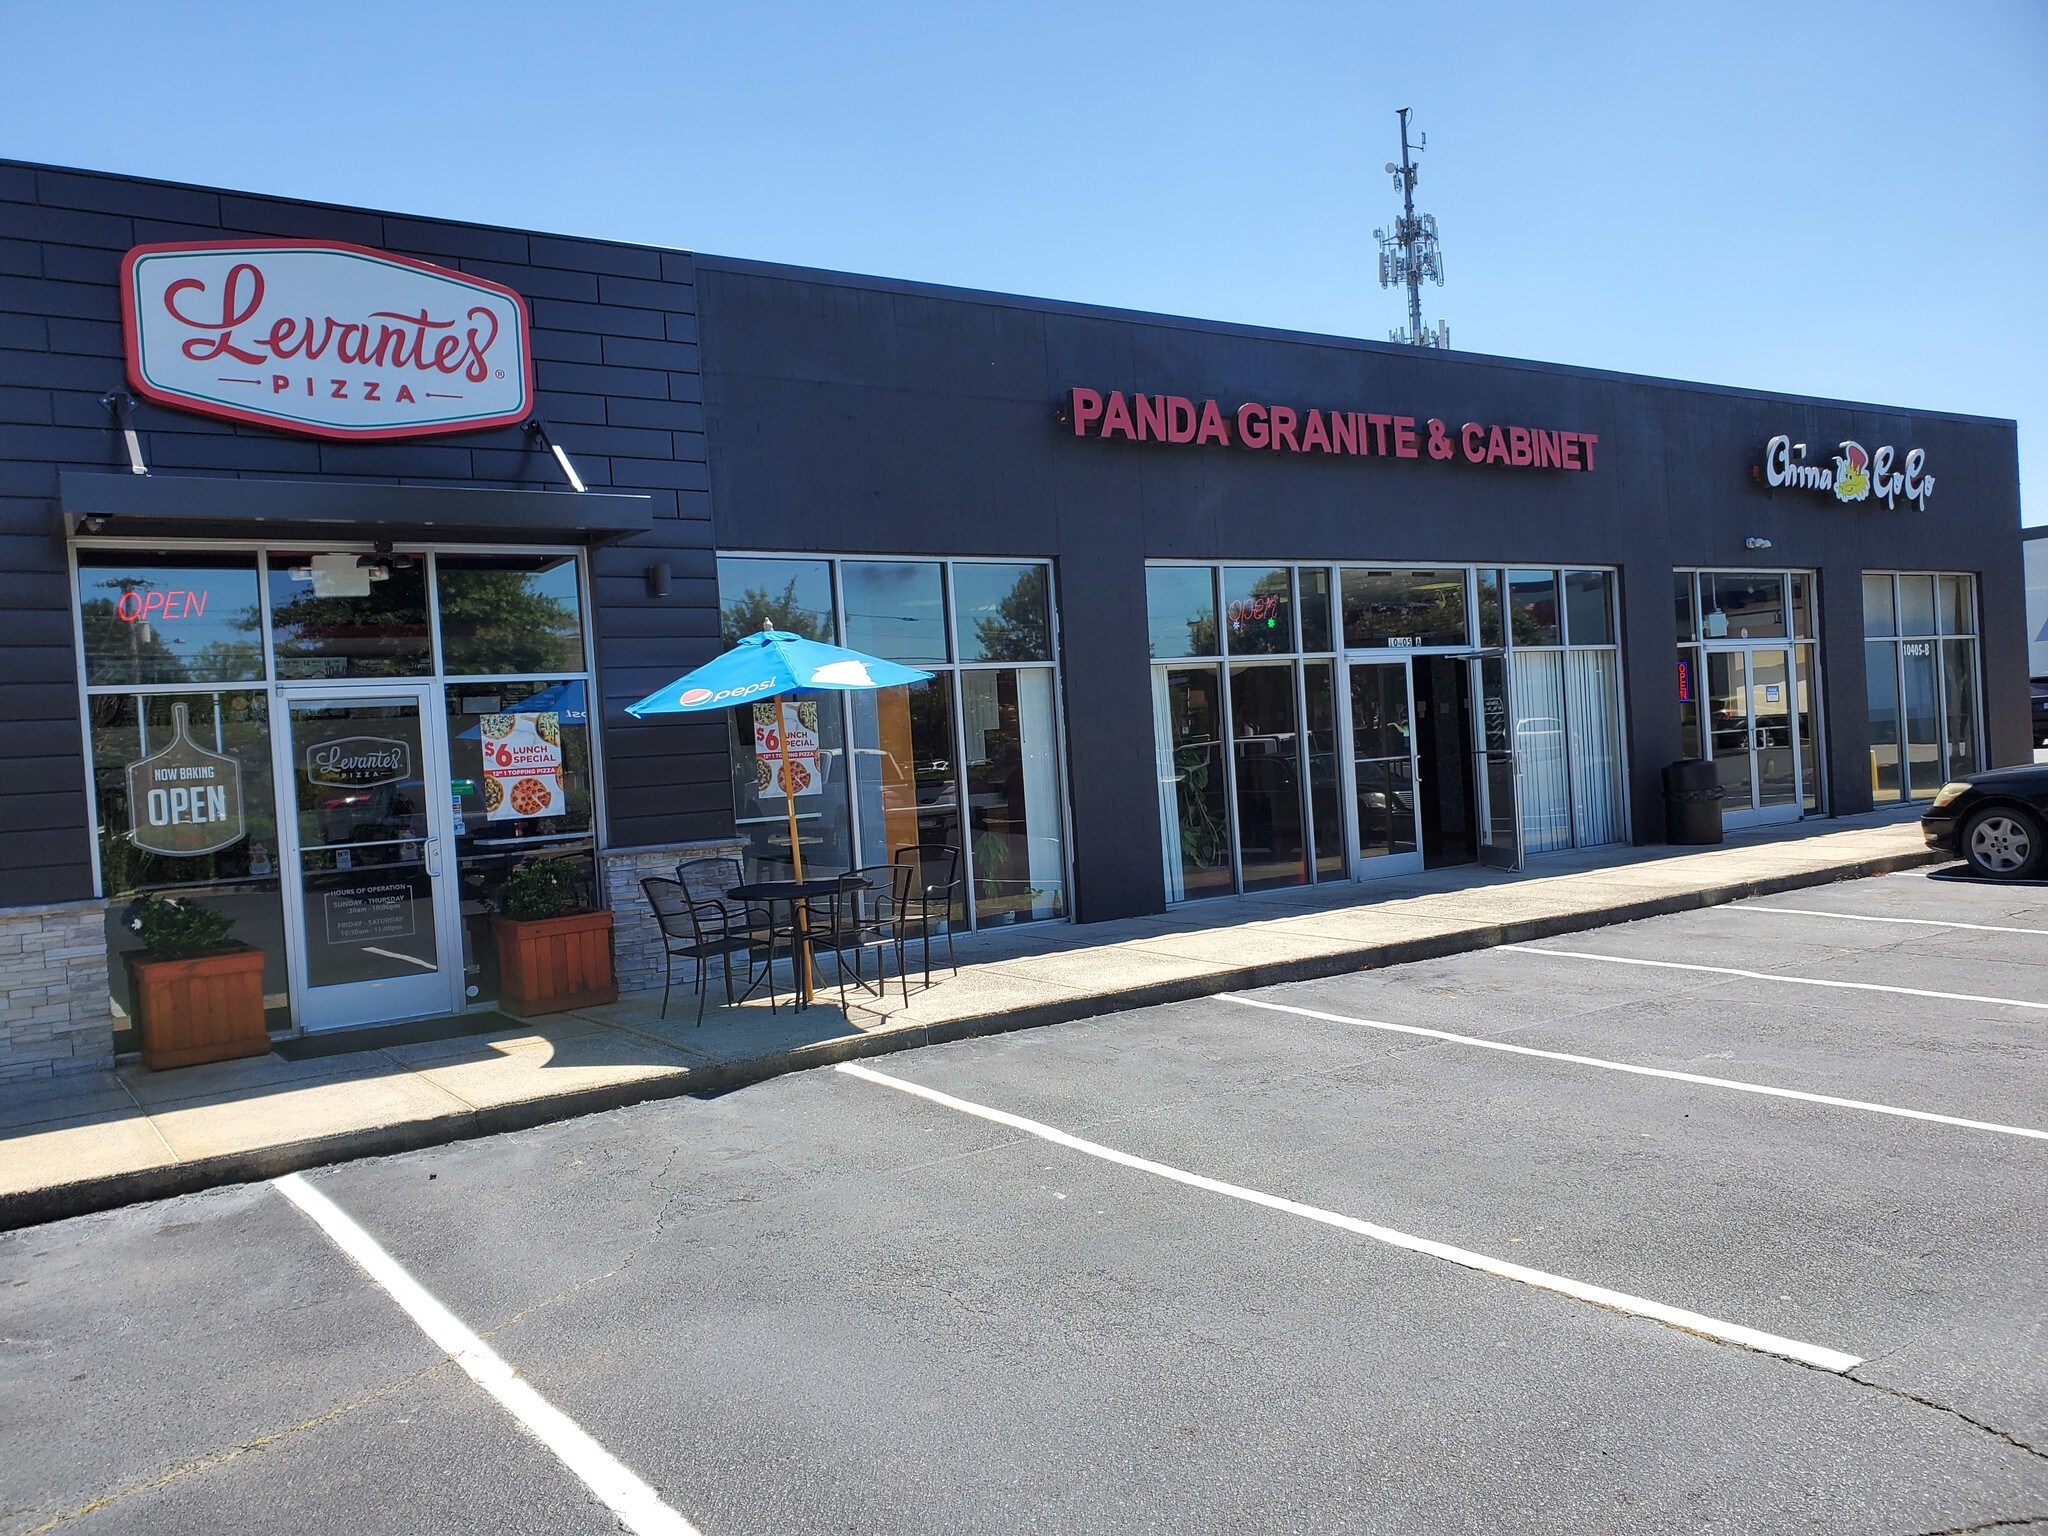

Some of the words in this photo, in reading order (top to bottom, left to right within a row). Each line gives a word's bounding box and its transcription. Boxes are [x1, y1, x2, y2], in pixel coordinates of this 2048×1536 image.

[164, 263, 498, 382] Levantes
[272, 374, 415, 404] PIZZA
[1072, 387, 1230, 446] PANDA
[1237, 402, 1419, 459] GRANITE
[1426, 418, 1456, 461] &
[1461, 421, 1599, 472] CABINET
[1766, 434, 1832, 490] China
[118, 590, 207, 622] OPEN
[1389, 638, 1412, 648] 1005
[1903, 643, 1930, 656] 10405-B
[712, 676, 777, 703] pepsi
[1679, 663, 1687, 700] OPEN
[756, 727, 780, 751] $6
[784, 731, 808, 739] UNCH
[316, 746, 401, 773] Levantes
[484, 741, 513, 767] $6
[513, 745, 548, 755] LUNCH
[513, 754, 556, 764] SPECIAL
[154, 768, 177, 781] NOW
[179, 766, 215, 780] BAKING
[341, 771, 379, 779] PIZZA
[507, 768, 537, 776] TOPPING
[147, 785, 226, 826] OPEN
[330, 888, 355, 897] HOURS
[367, 884, 406, 893] OPERATION
[333, 899, 363, 908] SUNDAY
[368, 895, 405, 904] THURSDAY
[337, 920, 363, 928] FRIDAY
[367, 916, 404, 925] SATURDAY
